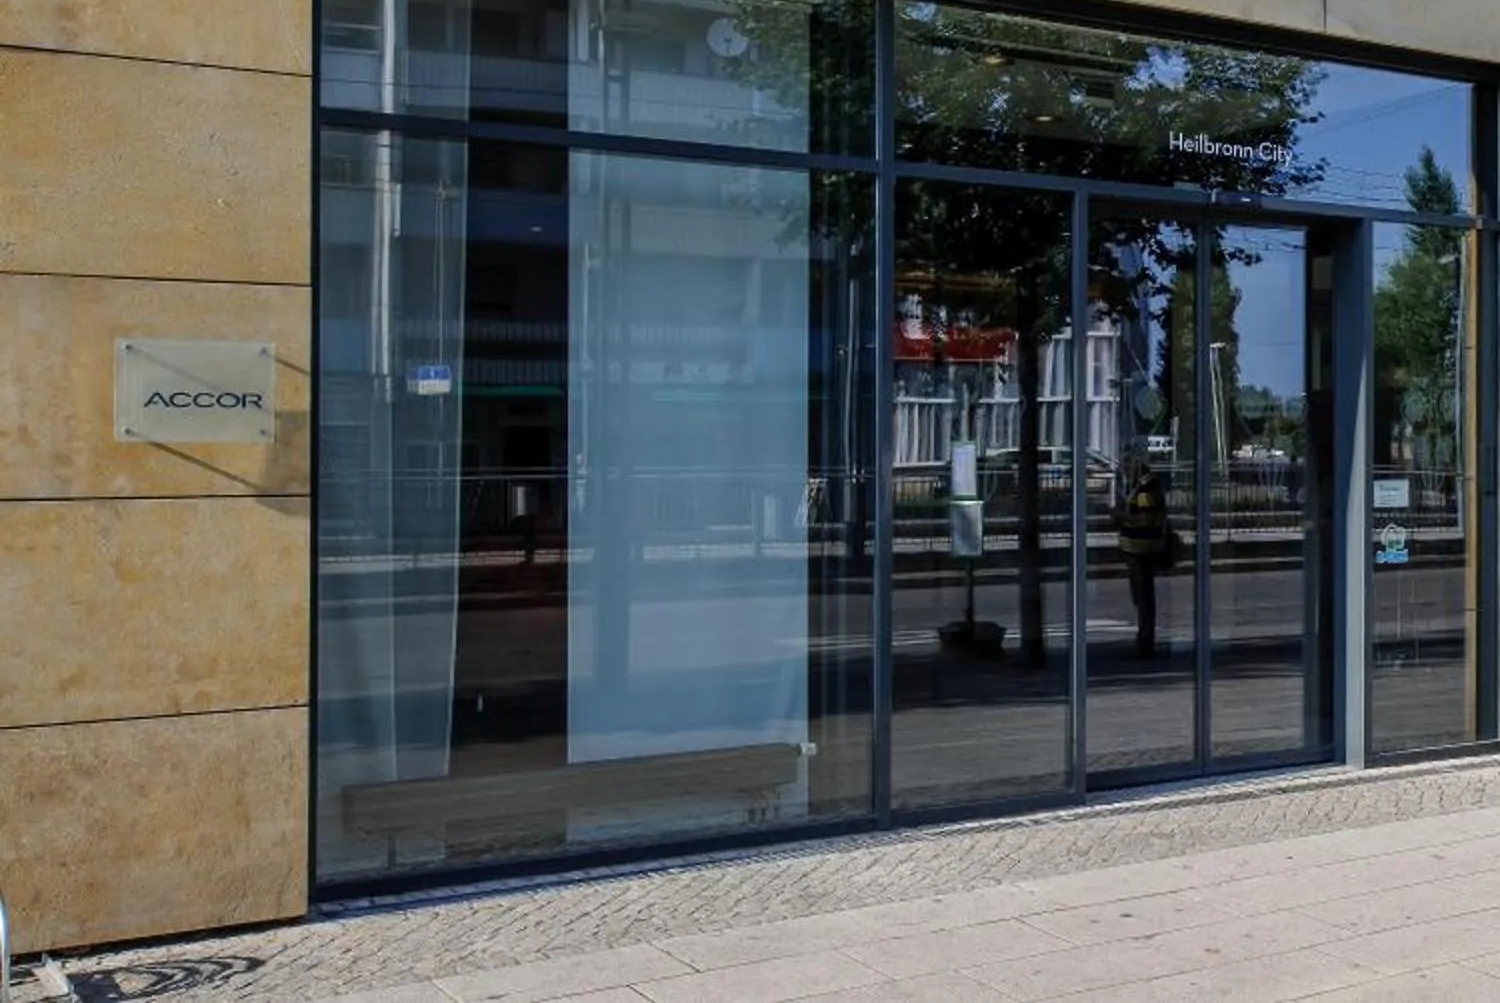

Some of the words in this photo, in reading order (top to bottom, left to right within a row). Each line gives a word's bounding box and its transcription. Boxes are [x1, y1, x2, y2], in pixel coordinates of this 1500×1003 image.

[1169, 131, 1253, 157] Heilbronn
[1259, 142, 1292, 166] City
[143, 392, 262, 408] ACCOR
